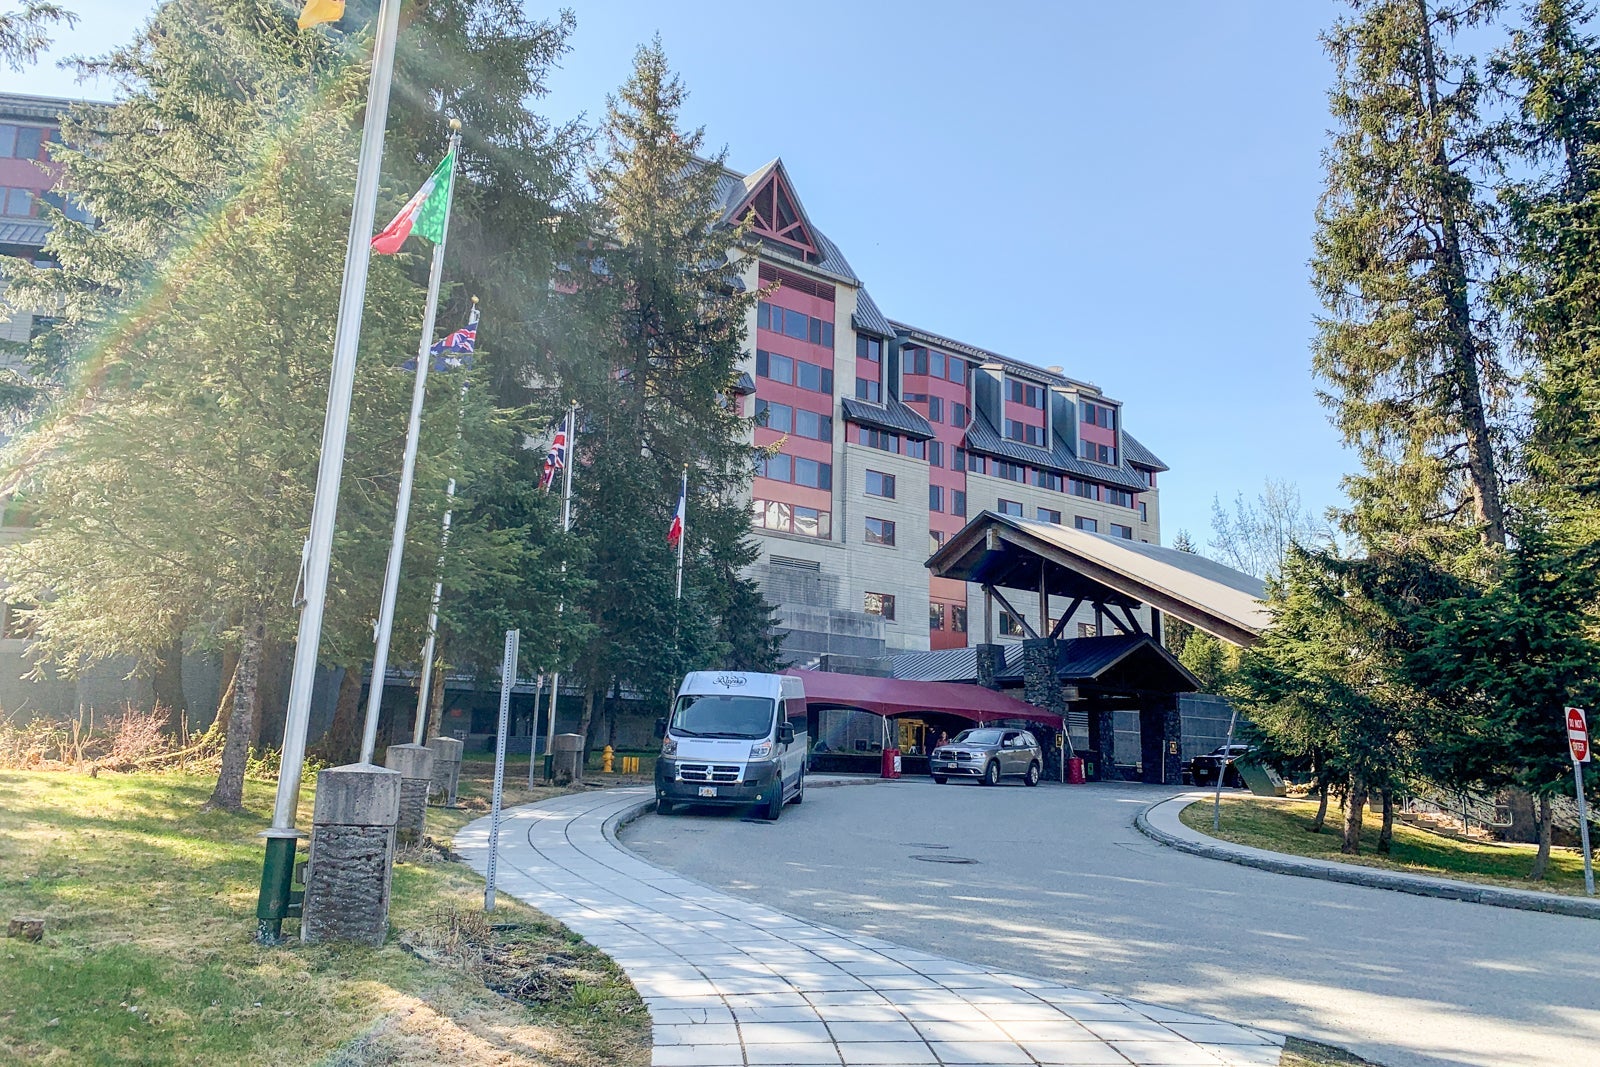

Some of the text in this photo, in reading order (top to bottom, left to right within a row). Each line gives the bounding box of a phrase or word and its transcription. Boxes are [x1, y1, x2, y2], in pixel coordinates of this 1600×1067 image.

[1568, 718, 1583, 729] DO NOT
[1572, 741, 1585, 752] ENTER
